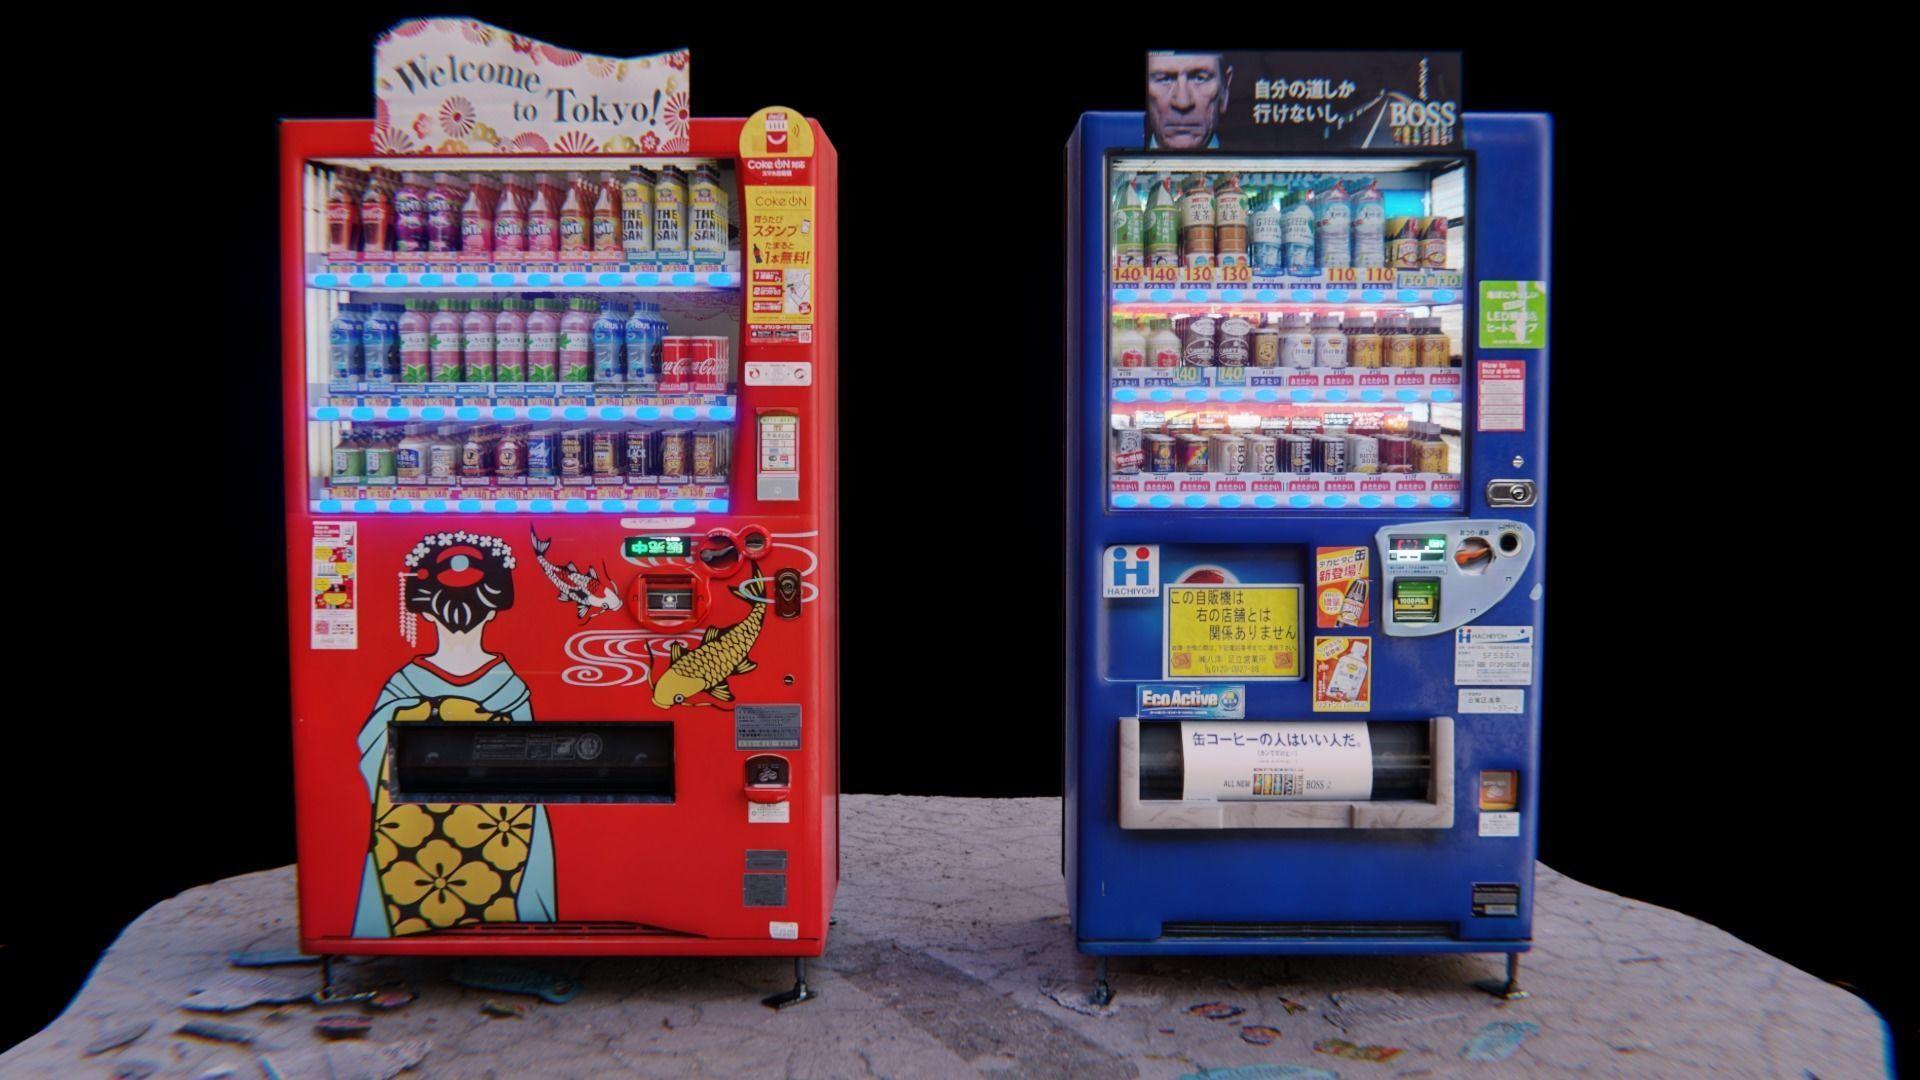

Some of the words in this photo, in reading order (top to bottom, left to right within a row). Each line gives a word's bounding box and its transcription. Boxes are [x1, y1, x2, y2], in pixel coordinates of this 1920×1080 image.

[394, 53, 541, 93] Welcome
[1254, 79, 1356, 100] 自分の道しか
[513, 99, 538, 122] to
[547, 88, 662, 126] Tokyo!
[1390, 101, 1457, 127] BOSS
[747, 160, 773, 170] Coke
[774, 158, 791, 170] ON
[755, 196, 786, 207] Coke
[788, 195, 807, 207] ON
[623, 209, 642, 219] THE
[657, 209, 677, 219] THE
[695, 209, 715, 219] THE
[622, 220, 643, 230] TAN
[656, 220, 678, 230] TAN
[694, 220, 716, 230] TAN
[753, 224, 799, 237] スタンプ
[622, 230, 643, 241] SAN
[656, 230, 678, 241] SAN
[694, 230, 716, 241] SAN
[1113, 267, 1141, 281] 140
[1149, 267, 1176, 281] 140
[1186, 267, 1212, 281] 130
[1222, 267, 1248, 281] 130
[1328, 267, 1355, 281] 110
[1367, 267, 1394, 281] 110
[1112, 378, 1137, 386] つめたい
[1146, 378, 1173, 386] つめたい
[1253, 378, 1280, 386] つめたい
[1236, 444, 1246, 472] BOS
[1264, 444, 1275, 472] BOS
[1107, 587, 1156, 596] HACHIYOH
[1171, 590, 1245, 606] この自販機は
[1197, 607, 1272, 623] 右の店舗とは
[1209, 624, 1297, 641] 関係ありません
[1192, 732, 1361, 748] 缶コーヒーの人はいい人だ。
[1306, 779, 1325, 790] BOSS
